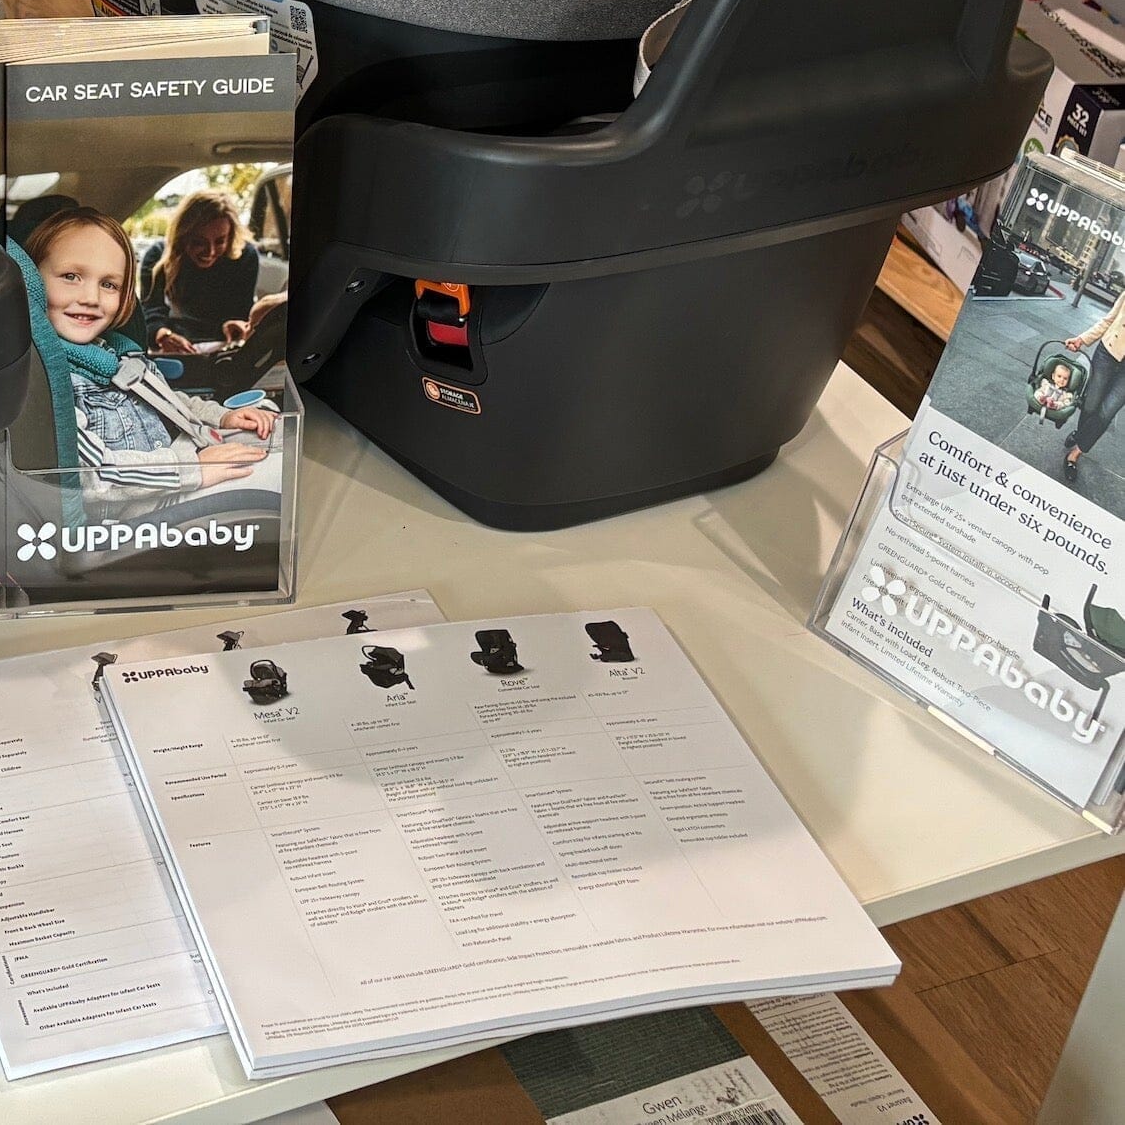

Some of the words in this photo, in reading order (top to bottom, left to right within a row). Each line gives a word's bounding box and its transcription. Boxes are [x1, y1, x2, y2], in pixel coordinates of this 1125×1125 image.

[25, 84, 68, 103] CAR
[73, 82, 124, 101] SEAT
[130, 79, 209, 99] SAFETY
[212, 77, 275, 95] GUIDE
[1071, 102, 1090, 127] 32
[1046, 198, 1125, 253] UPPAbab
[919, 451, 934, 469] at
[935, 459, 967, 487] just
[969, 481, 1017, 517] under
[1018, 510, 1044, 534] six
[1042, 527, 1109, 576] pounds.
[928, 430, 994, 478] Comfort
[995, 471, 1010, 489] &
[1012, 482, 1113, 550] convenience
[61, 519, 256, 553] UPPAbaby
[900, 493, 914, 505] out
[913, 501, 947, 522] extended
[946, 520, 977, 544] sunshade
[905, 481, 940, 509] Extra-large
[940, 502, 955, 516] UPF
[967, 519, 992, 539] vented
[991, 536, 1017, 556] canopy
[1017, 552, 1033, 566] with
[1033, 562, 1049, 575] pop
[885, 525, 925, 555] No-rethread
[924, 550, 951, 572] 5-point
[950, 565, 976, 588] harness
[928, 574, 947, 591] Gold
[945, 584, 976, 609] Certified
[886, 620, 934, 660] included
[909, 584, 944, 611] ergonomic
[975, 627, 1021, 660] carry-handle
[138, 664, 210, 680] UPPAbaby
[631, 666, 646, 676] V2
[840, 619, 861, 638] Infant
[859, 631, 880, 650] Insert,
[879, 643, 906, 667] Limited
[904, 660, 934, 684] Lifetime
[932, 678, 964, 707] Warranty
[845, 609, 869, 629] Carrier,
[884, 633, 900, 649] with
[899, 643, 918, 661] Load
[930, 665, 958, 689] Robust
[904, 594, 1100, 745] UPPAbaby
[285, 706, 300, 717] V2
[642, 1096, 683, 1116] Gwen
